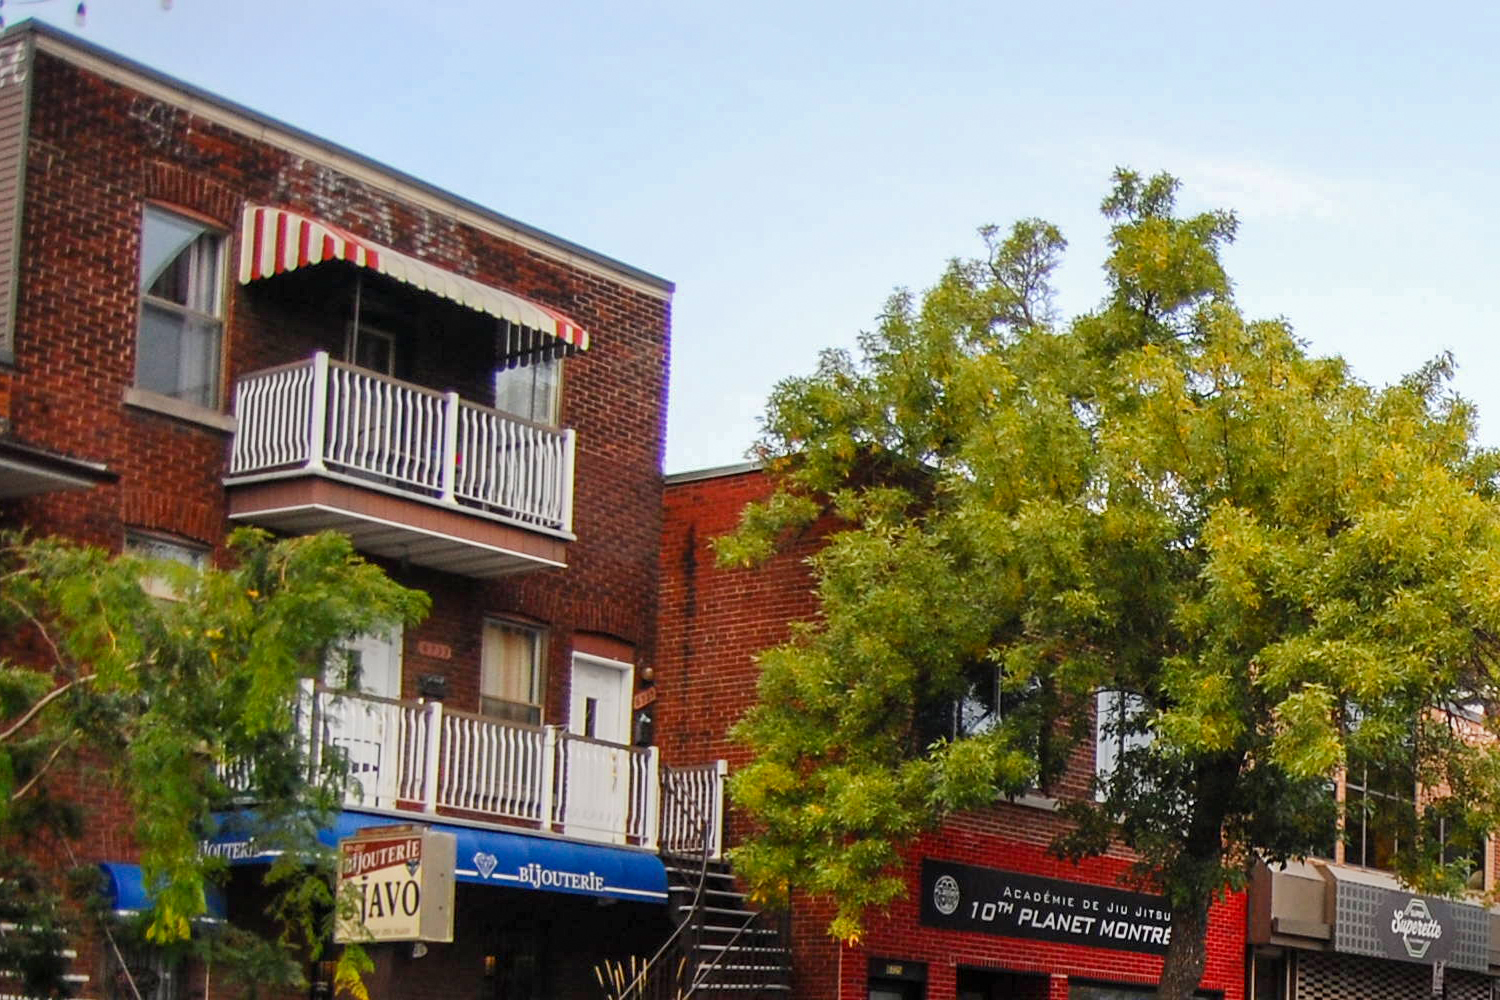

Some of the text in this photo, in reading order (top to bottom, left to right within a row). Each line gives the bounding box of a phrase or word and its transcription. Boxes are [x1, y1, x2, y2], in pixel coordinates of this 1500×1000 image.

[519, 863, 605, 891] BIJOUTERIE
[971, 901, 1014, 921] 10TH
[1018, 908, 1096, 935] PLANET
[1003, 886, 1171, 921] ACADÉMIE DE JIU JITSU
[1391, 909, 1442, 939] Superette
